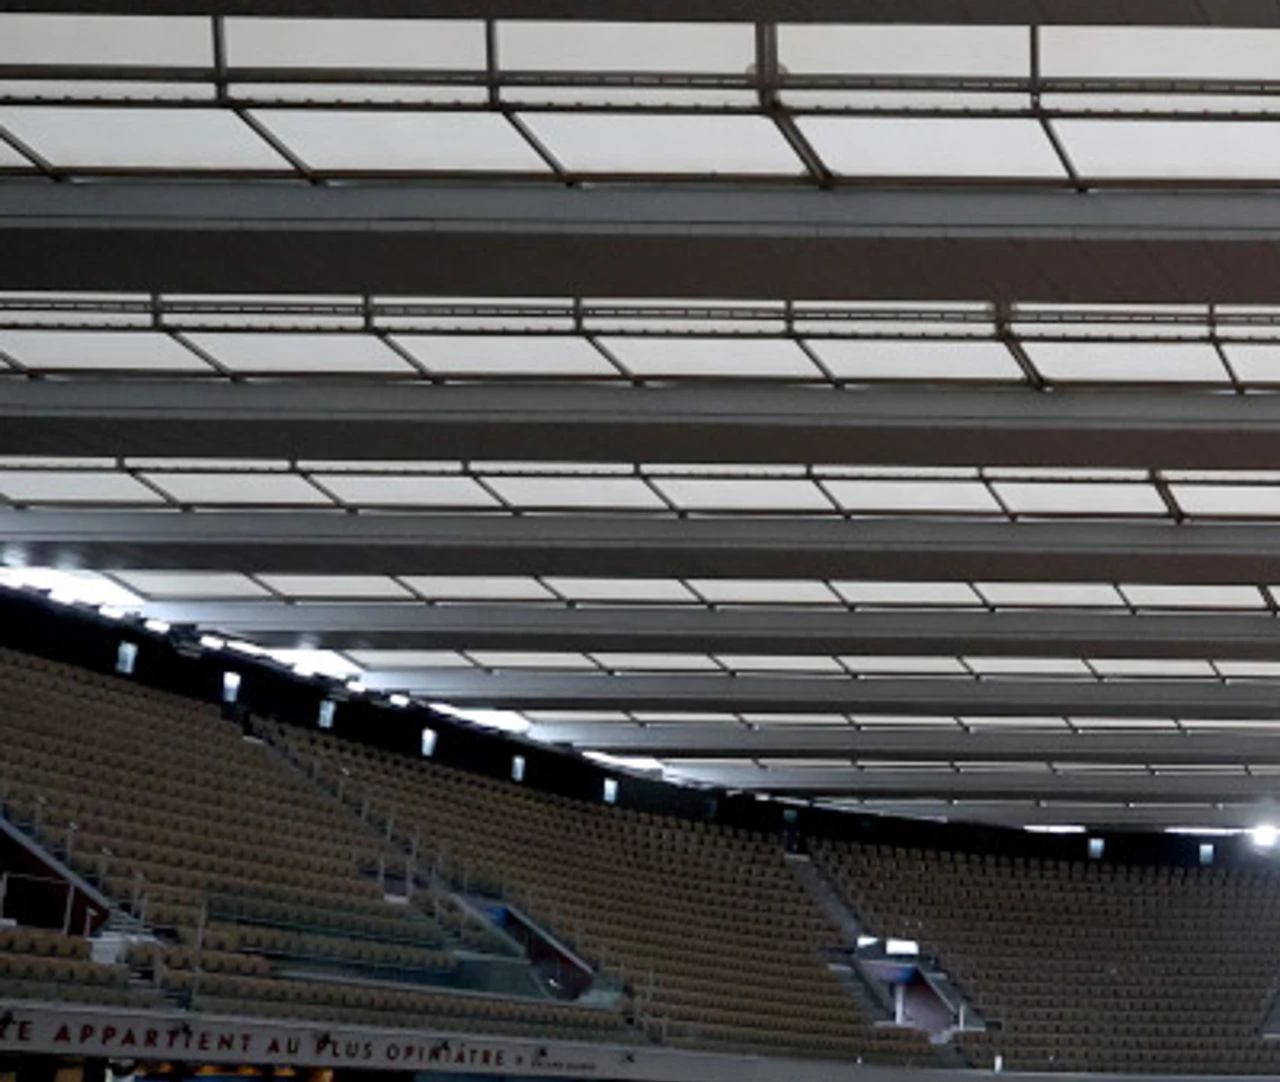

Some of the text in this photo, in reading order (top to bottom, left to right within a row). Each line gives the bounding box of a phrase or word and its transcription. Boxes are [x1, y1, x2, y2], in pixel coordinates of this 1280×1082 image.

[53, 1024, 251, 1053] APPARTIENT
[267, 1037, 301, 1055] AU
[315, 1038, 372, 1059] PLUS
